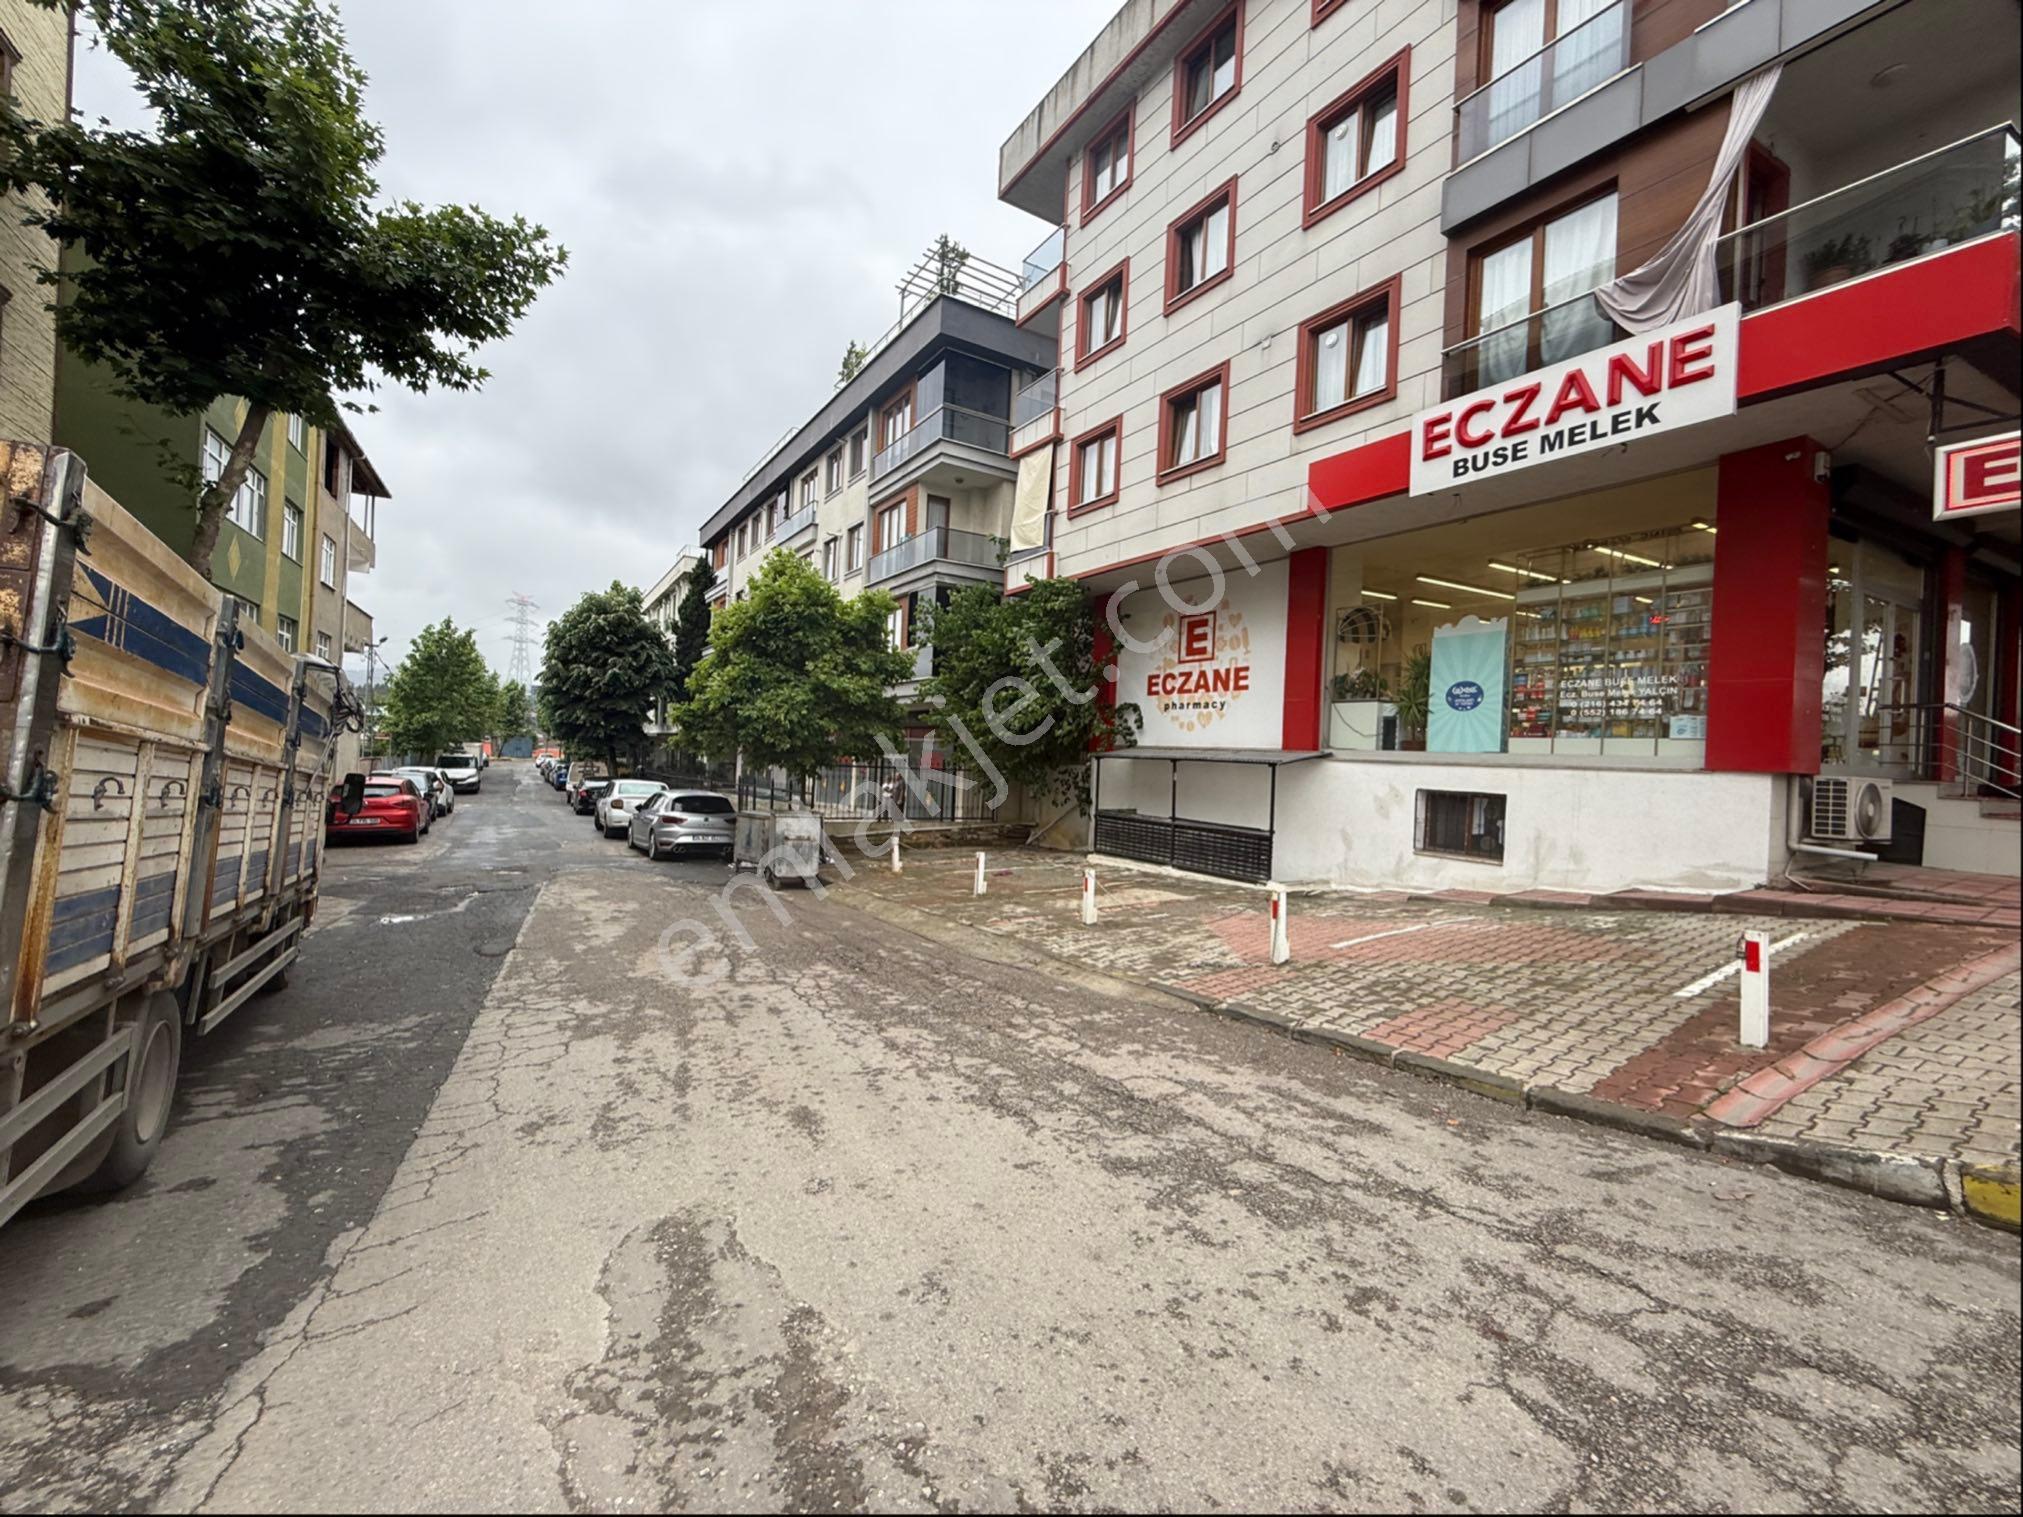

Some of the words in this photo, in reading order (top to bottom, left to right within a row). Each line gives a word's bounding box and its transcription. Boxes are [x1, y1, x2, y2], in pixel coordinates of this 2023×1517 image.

[1422, 323, 1715, 462] ECZANE
[1452, 440, 1528, 478] BUSE
[1540, 402, 1661, 454] MELEK
[1964, 447, 2021, 500] E
[1185, 618, 1209, 657] E
[1147, 667, 1250, 696] ECZANE
[1560, 679, 1602, 688] ECZANE
[1637, 675, 1678, 684] MELEK
[1581, 690, 1605, 698] Buse
[1639, 687, 1678, 696] YALÇIN
[1163, 700, 1226, 712] pharmacy
